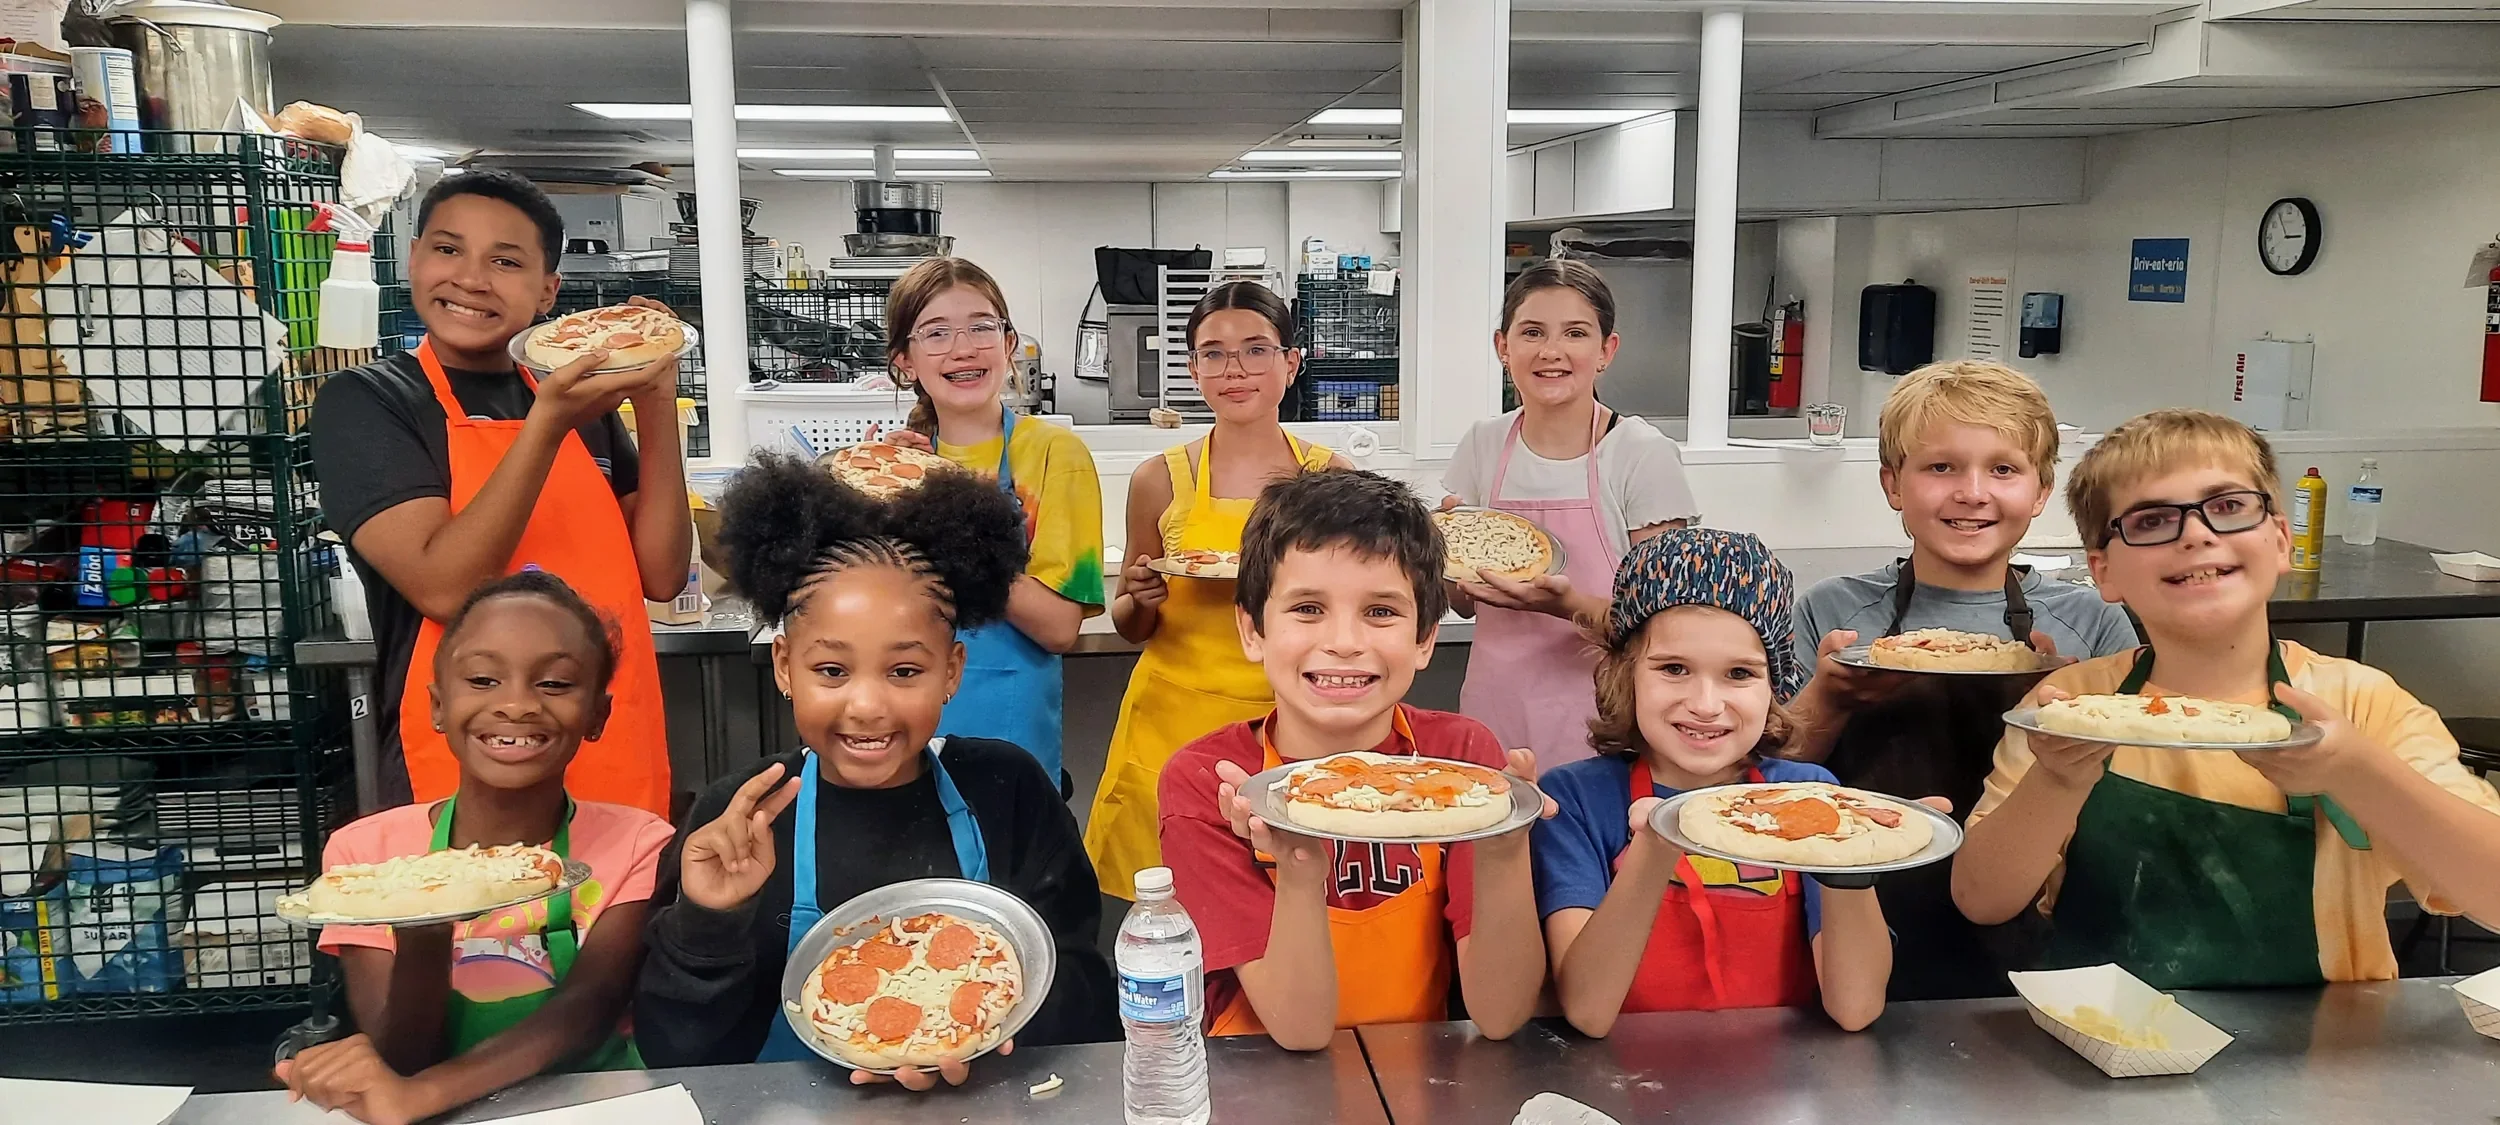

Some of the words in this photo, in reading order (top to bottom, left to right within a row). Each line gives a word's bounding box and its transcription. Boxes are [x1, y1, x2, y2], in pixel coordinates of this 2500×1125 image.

[2236, 353, 2245, 373] Aid
[2234, 375, 2243, 401] First
[83, 554, 103, 594] Zploc
[354, 699, 365, 716] 2
[1133, 992, 1158, 1006] Water
